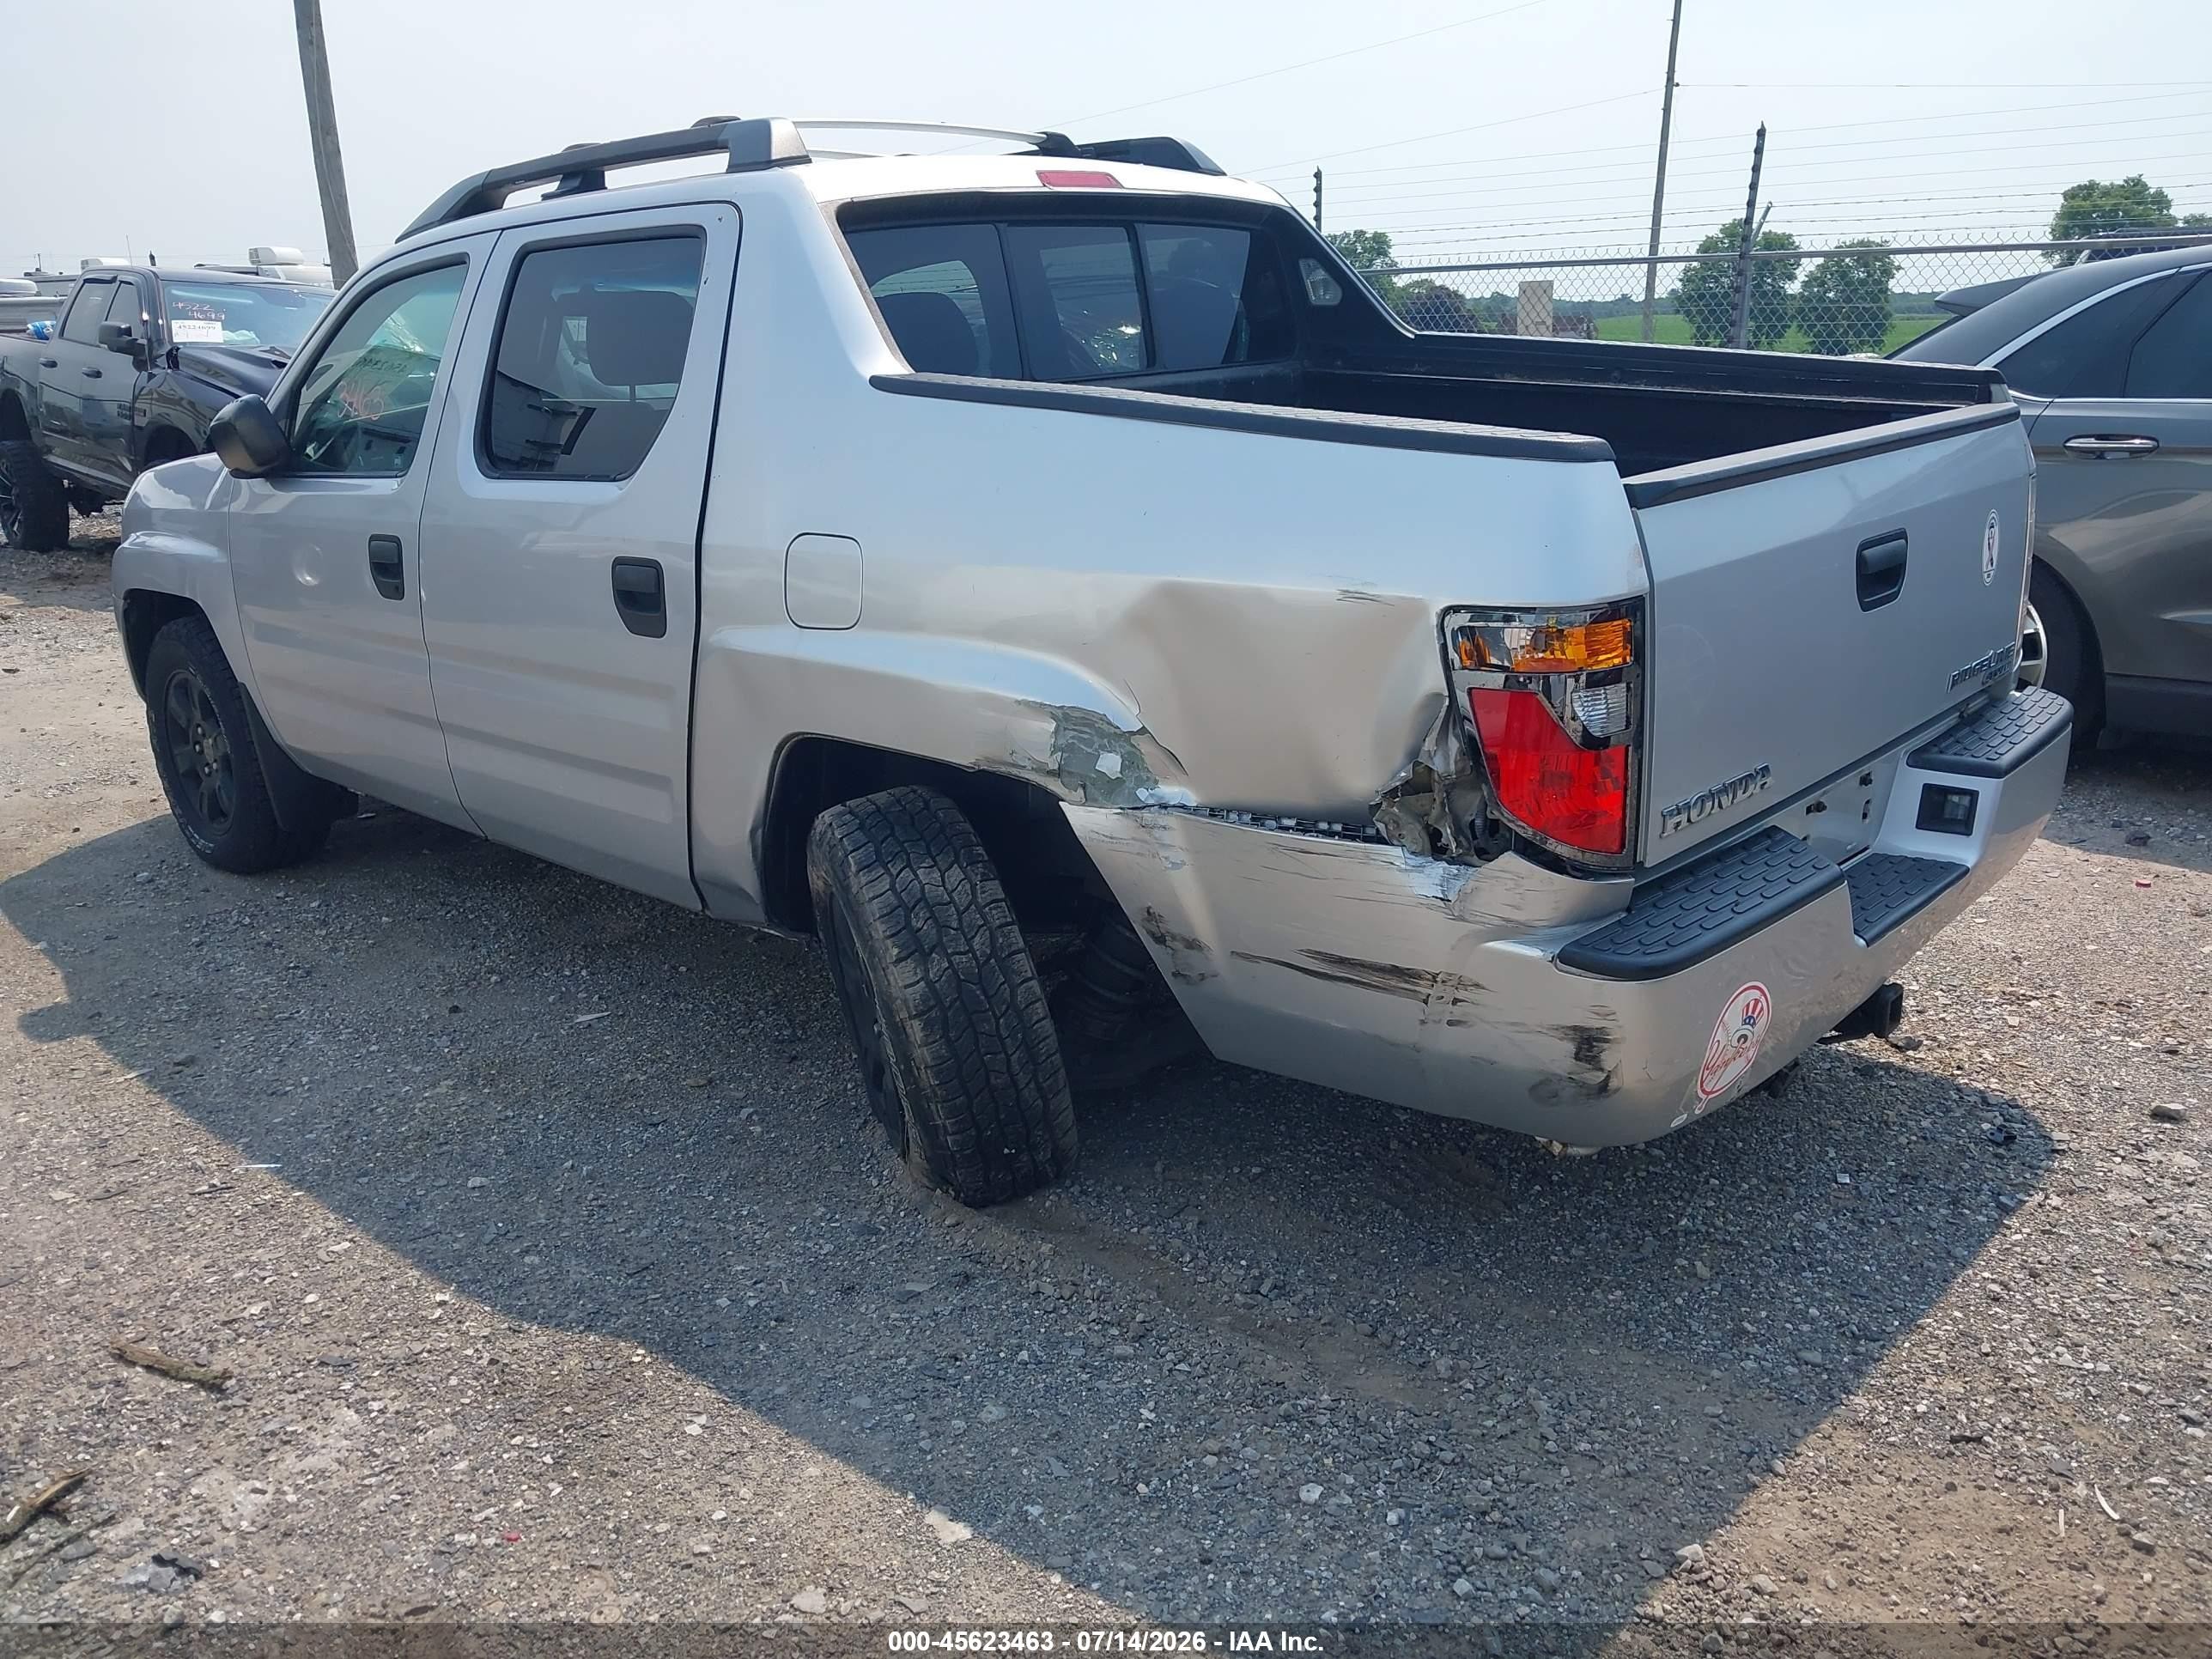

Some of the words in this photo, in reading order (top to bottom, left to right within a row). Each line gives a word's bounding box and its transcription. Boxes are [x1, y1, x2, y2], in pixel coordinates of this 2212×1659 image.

[172, 301, 214, 311] 4522
[189, 311, 225, 321] 4699
[1659, 763, 1772, 837] HONDA
